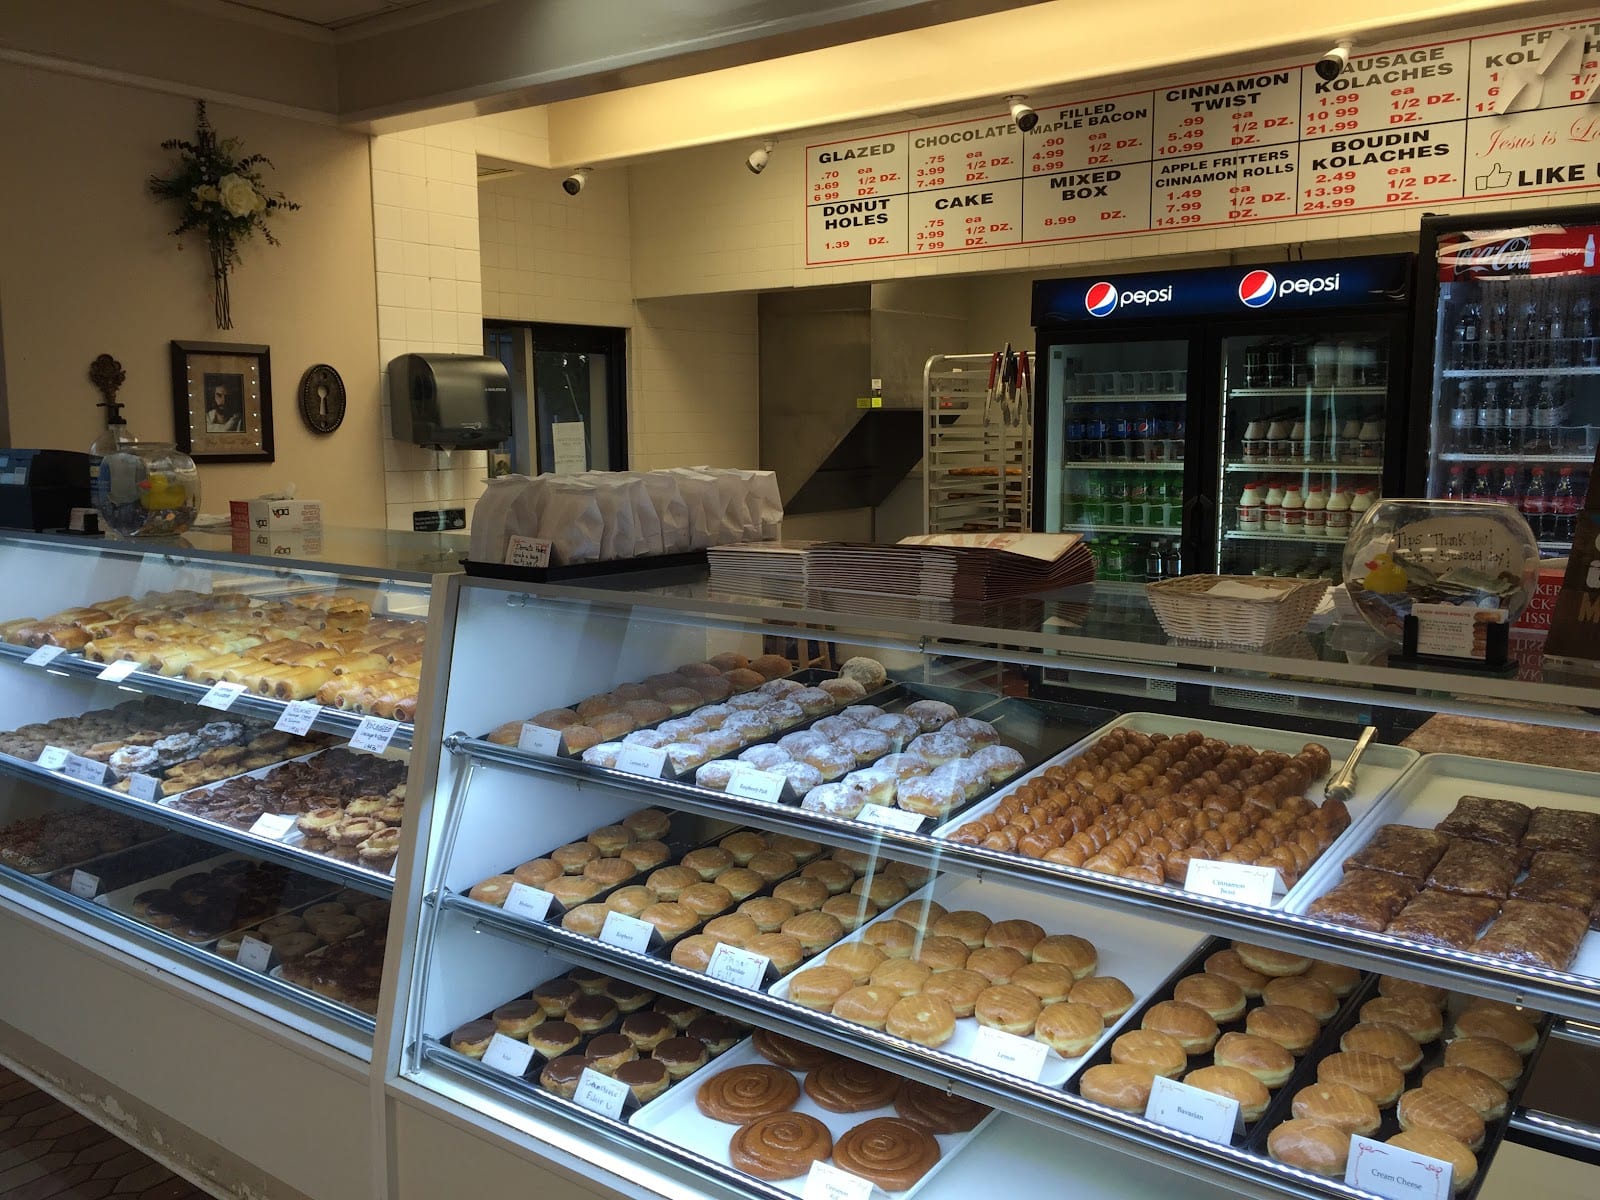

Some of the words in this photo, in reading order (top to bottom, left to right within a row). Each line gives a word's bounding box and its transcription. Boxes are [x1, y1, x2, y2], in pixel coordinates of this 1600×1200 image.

[1340, 47, 1445, 74] AUSAGE
[1166, 73, 1289, 102] CINNAMON
[1316, 62, 1453, 94] KOLACHES
[1191, 93, 1261, 113] TWIST
[1320, 93, 1359, 106] 1.99
[1391, 87, 1414, 96] ea
[1391, 98, 1420, 110] 1/2
[1427, 93, 1461, 104] DZ.
[1060, 103, 1115, 120] FILLED
[1179, 116, 1204, 127] .99
[1232, 111, 1253, 119] ea
[1029, 119, 1082, 135] MAPLE
[1089, 109, 1146, 126] BACON
[1168, 129, 1204, 141] 5.49
[1232, 122, 1257, 132] 1/2
[1264, 117, 1294, 128] DZ.
[1306, 121, 1358, 135] 21.99
[1390, 112, 1422, 123] DZ.
[915, 124, 1017, 149] CHOCOLATE
[1042, 138, 1064, 147] .90
[1158, 142, 1203, 155] 10.99
[1232, 135, 1260, 145] DZ.
[1332, 130, 1430, 153] BOUDIN
[819, 143, 895, 163] GLAZED
[925, 156, 944, 165] .75
[966, 151, 982, 159] ea
[1032, 150, 1064, 160] 4.99
[1089, 143, 1111, 152] 1/2
[1117, 138, 1142, 149] DZ.
[1312, 144, 1449, 170] KOLACHES
[917, 167, 944, 176] 3.99
[967, 161, 986, 170] 1/2
[991, 157, 1013, 166] DZ.
[1032, 162, 1064, 172] 8.99
[1088, 155, 1113, 164] DZ.
[1161, 160, 1208, 174] APPLE
[1214, 150, 1289, 167] FRITTERS
[814, 182, 839, 191] 3.69
[859, 176, 876, 185] 1/2
[880, 173, 900, 181] DZ.
[821, 171, 839, 179] .70
[917, 178, 944, 188] 7.49
[966, 172, 988, 181] DZ.
[1051, 170, 1121, 189] MIXED
[1156, 170, 1237, 188] CINNAMON
[1243, 164, 1294, 178] ROLLS
[1316, 171, 1356, 183] 2.49
[1387, 166, 1411, 175] ea
[1518, 164, 1585, 186] LIKE
[858, 187, 878, 195] DZ.
[1062, 186, 1108, 201] BOX
[1167, 189, 1201, 200] 1.49
[1229, 186, 1250, 194] ea
[1304, 185, 1355, 197] 13.99
[1388, 178, 1416, 189] 1/2
[1424, 174, 1456, 185] DZ.
[823, 199, 890, 216] DONUT
[935, 193, 993, 210] CAKE
[1166, 202, 1201, 213] 7.99
[1230, 196, 1255, 206] 1/2
[1262, 192, 1291, 203] DZ.
[1303, 198, 1355, 211] 24.99
[1387, 192, 1419, 203] DZ.
[825, 213, 888, 230] HOLES
[925, 220, 944, 228] .75
[1045, 216, 1076, 226] 8.99
[1101, 211, 1126, 220] DZ.
[1157, 215, 1201, 226] 14.99
[1229, 209, 1258, 219] DZ.
[917, 231, 944, 239] 3.99
[966, 226, 985, 234] 1/2
[990, 223, 1013, 232] DZ.
[826, 241, 849, 249] 1.39
[869, 237, 888, 245] DZ.
[966, 238, 987, 246] DZ.
[1279, 273, 1340, 297] pepsi
[1120, 285, 1173, 308] pepsi
[1177, 1106, 1204, 1120] Bavarian
[1371, 1168, 1395, 1182] Cream
[1396, 1176, 1423, 1190] Cheese
